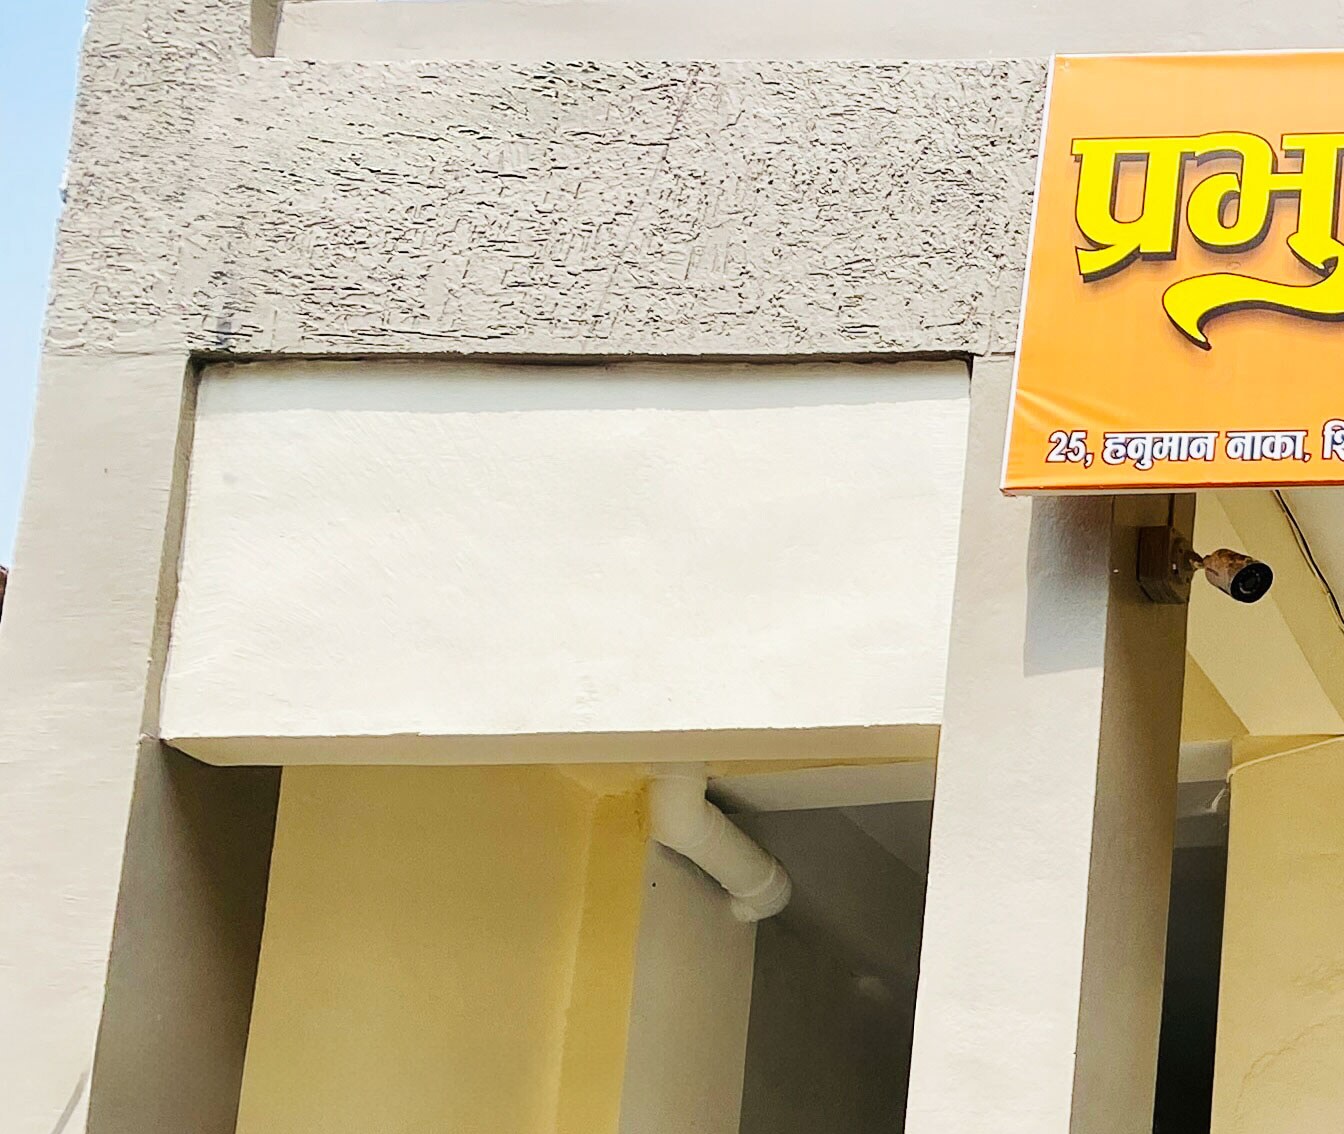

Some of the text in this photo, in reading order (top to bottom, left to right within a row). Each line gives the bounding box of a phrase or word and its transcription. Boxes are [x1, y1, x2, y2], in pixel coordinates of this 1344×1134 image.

[1047, 431, 1093, 468] 25,
[1102, 430, 1219, 470] हनुमान
[1227, 430, 1312, 463] नाका,
